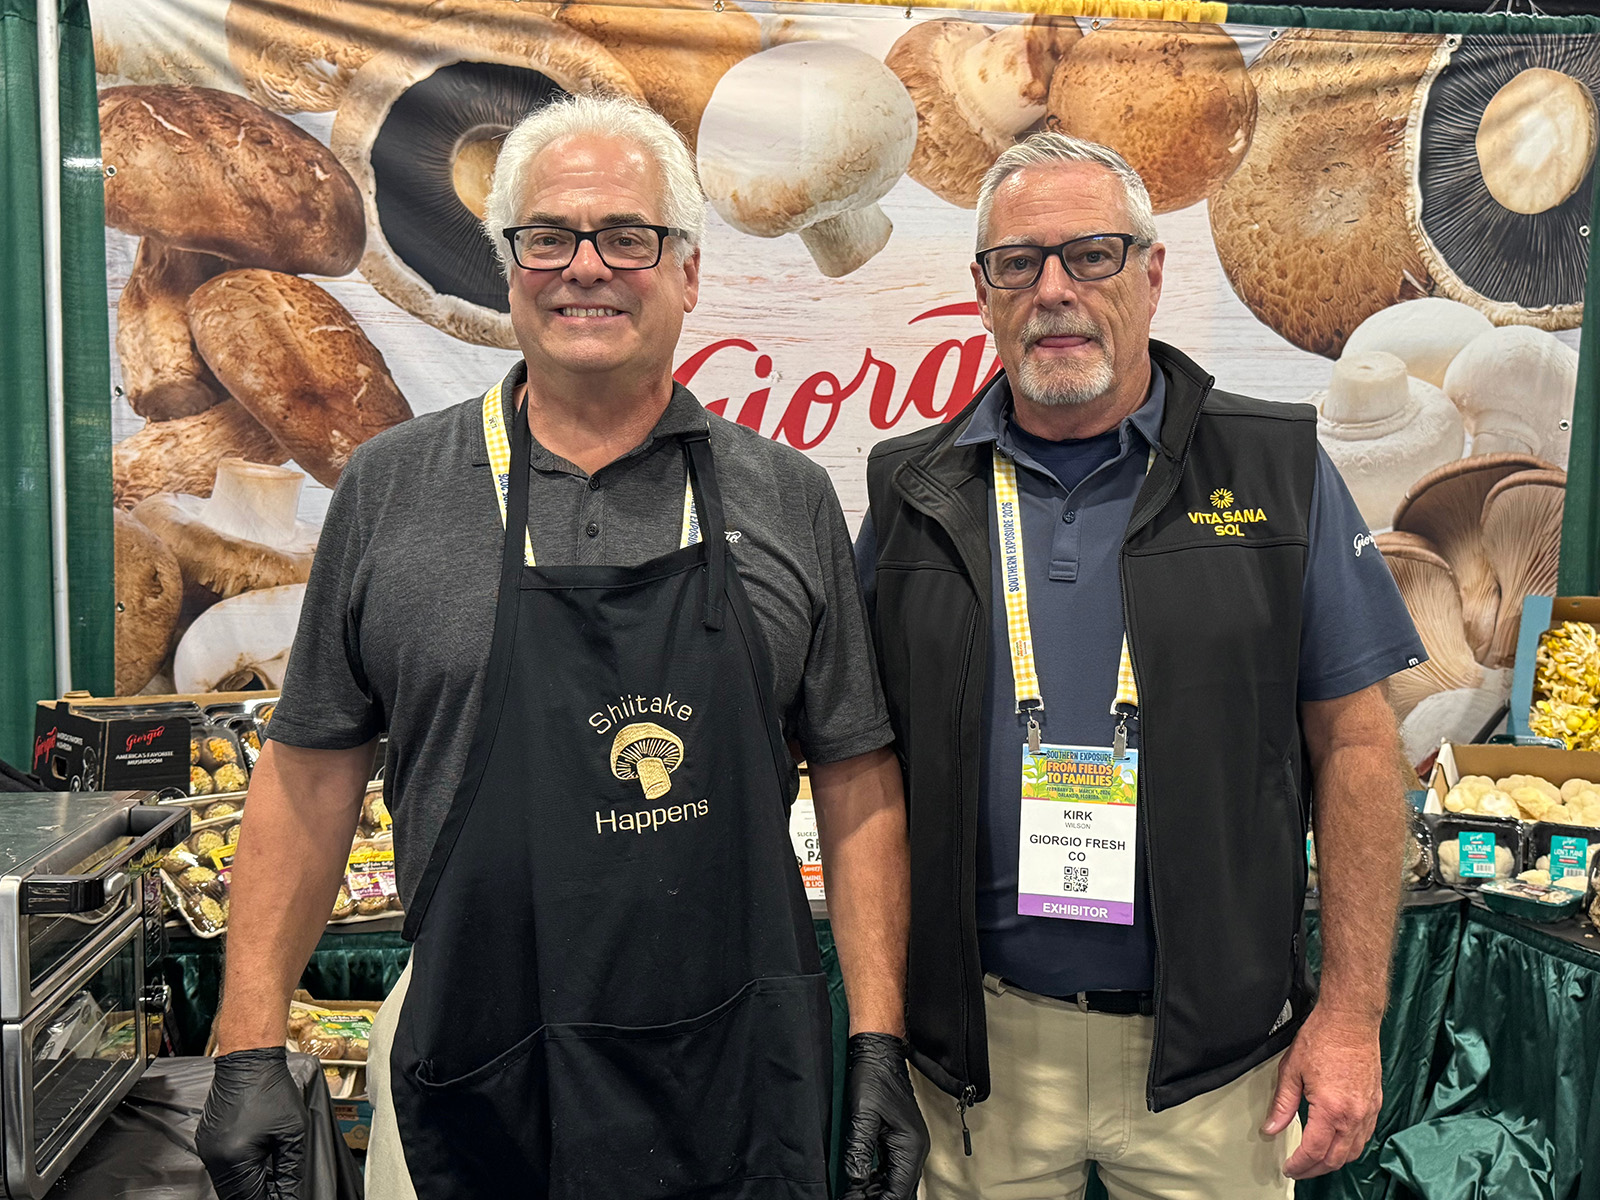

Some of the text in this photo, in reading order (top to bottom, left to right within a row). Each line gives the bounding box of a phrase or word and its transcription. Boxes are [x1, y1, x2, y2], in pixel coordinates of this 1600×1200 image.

[1214, 523, 1245, 537] SOL
[1001, 501, 1020, 593] SOUTHERN EXPOSURE 2026
[588, 693, 693, 735] Shiitake
[125, 726, 165, 752] Giorgio
[1046, 750, 1112, 762] SOUTHERN EXPOSURE
[1047, 761, 1113, 776] FROM FIELDS
[1047, 772, 1113, 787] TO FAMILIES
[595, 799, 709, 834] Happens
[1063, 810, 1093, 821] KIRK
[1065, 822, 1091, 830] WILSON
[1029, 834, 1126, 850] GIORGIO FRESH
[1068, 851, 1086, 862] CO
[1043, 902, 1109, 918] EXHIBITOR
